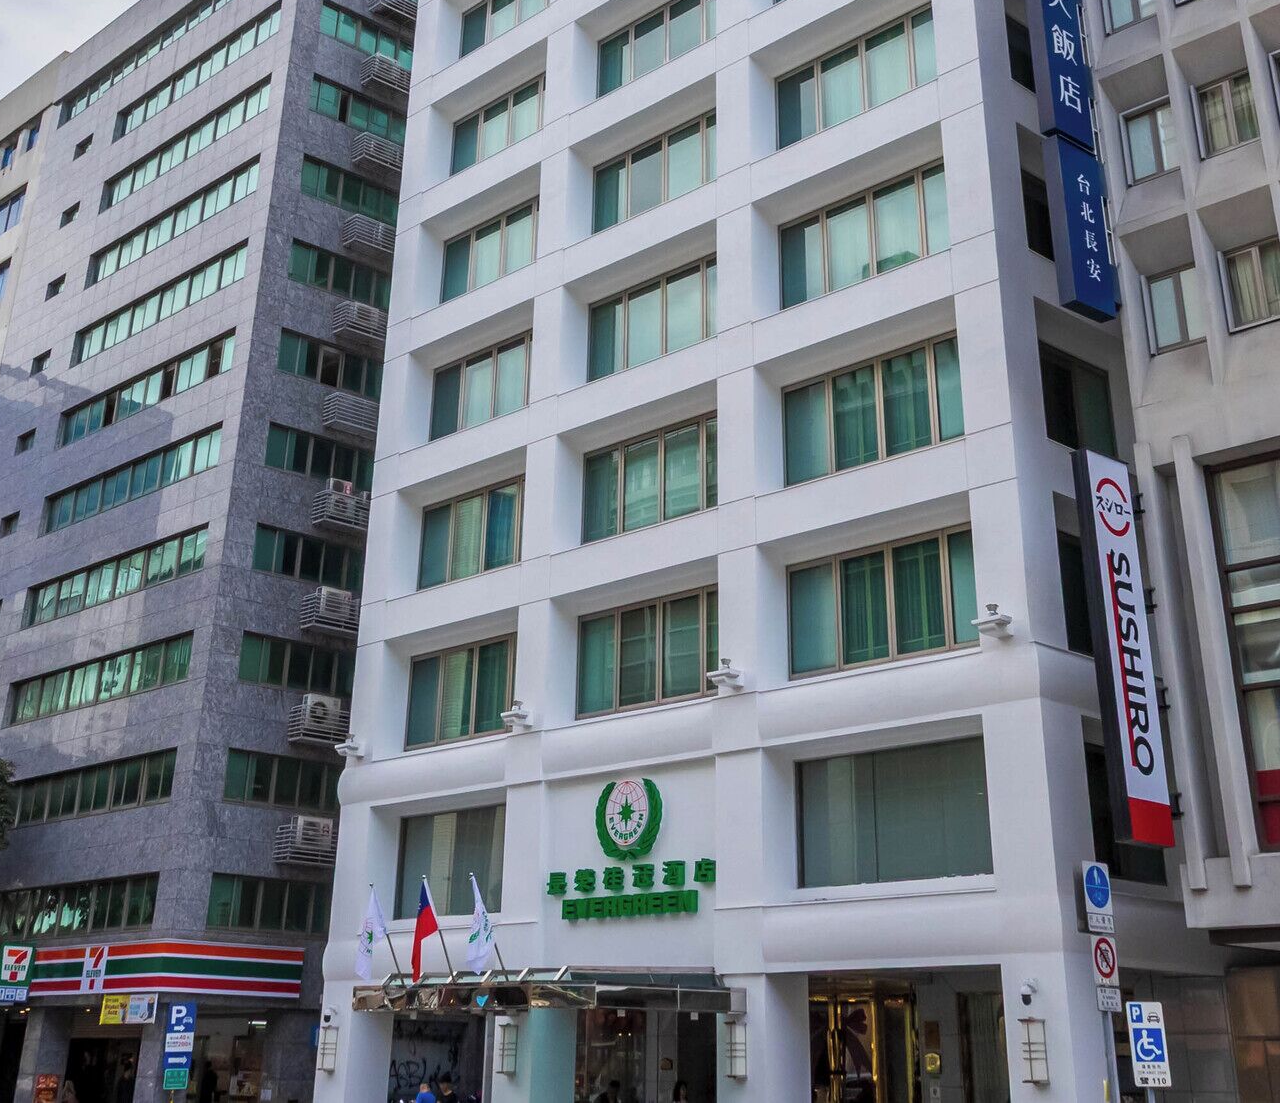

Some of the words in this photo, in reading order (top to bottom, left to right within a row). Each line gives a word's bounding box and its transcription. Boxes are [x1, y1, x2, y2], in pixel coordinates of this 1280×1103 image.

[1077, 173, 1101, 283] 台北長安
[1096, 494, 1131, 518] スシロー
[1111, 549, 1154, 776] SUSHIRO
[608, 812, 645, 841] EVERGREEN
[562, 890, 699, 920] EVERGREEN
[171, 1005, 187, 1025] P
[1132, 1006, 1141, 1020] P
[1152, 1077, 1167, 1085] 110
